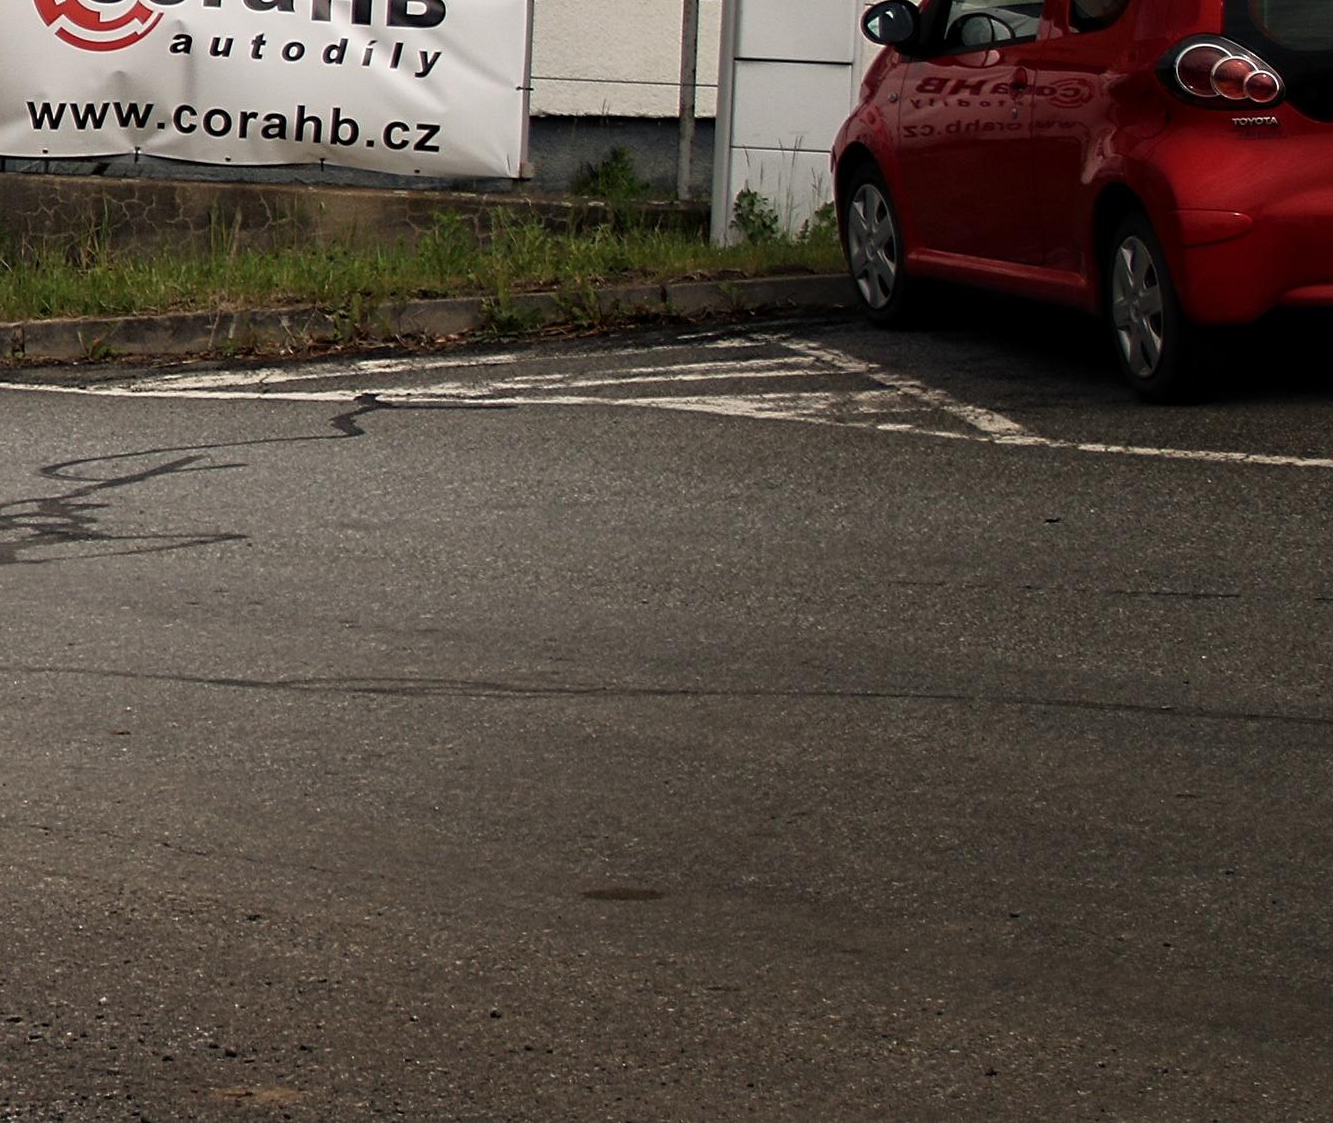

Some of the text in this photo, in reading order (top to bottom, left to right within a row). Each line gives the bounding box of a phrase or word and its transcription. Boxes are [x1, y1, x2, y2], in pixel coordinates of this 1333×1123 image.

[169, 29, 443, 78] autodíly
[27, 99, 442, 153] www.corahb.cz
[1232, 116, 1278, 126] TOYOTA
